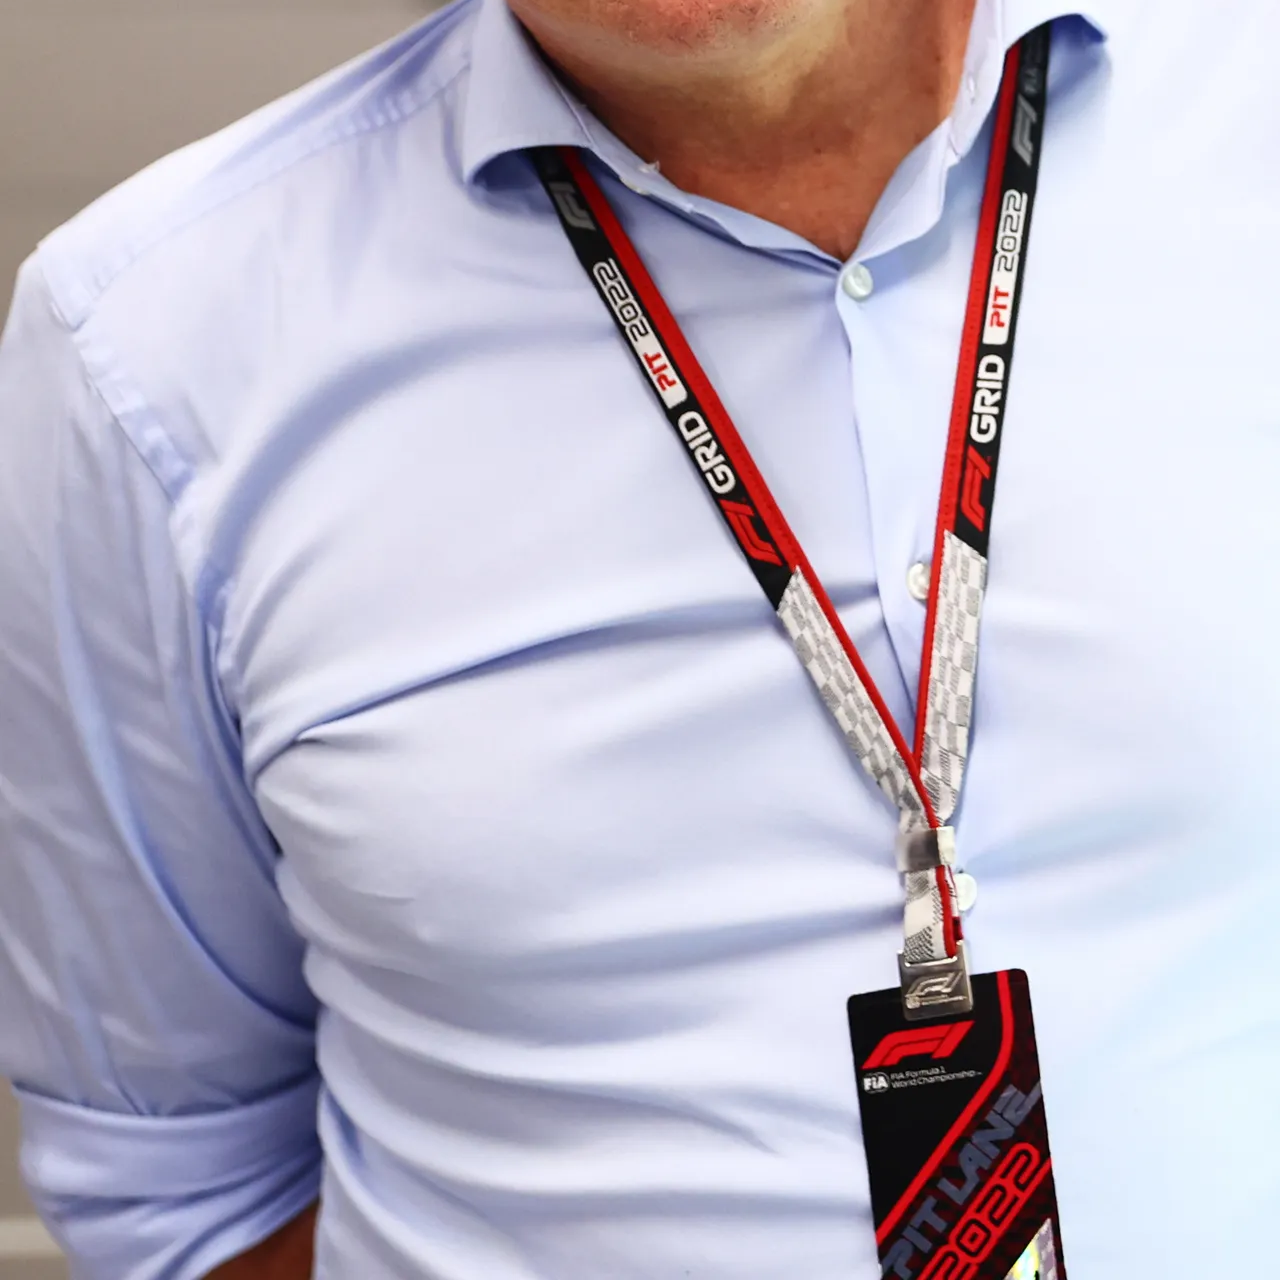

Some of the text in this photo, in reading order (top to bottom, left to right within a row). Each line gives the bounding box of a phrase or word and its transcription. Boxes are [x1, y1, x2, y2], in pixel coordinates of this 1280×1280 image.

[998, 189, 1029, 273] 2022
[592, 258, 650, 344] 2022
[990, 286, 1010, 328] PIT
[643, 352, 678, 393] PIT
[970, 354, 1005, 444] GRID
[678, 410, 736, 495] GRID
[861, 1020, 975, 1069] F1
[891, 1070, 976, 1089] World Championship
[905, 1067, 940, 1078] Formula
[881, 1195, 949, 1280] PIT
[936, 1080, 1042, 1206] LANE
[916, 1142, 1051, 1280] 2022
